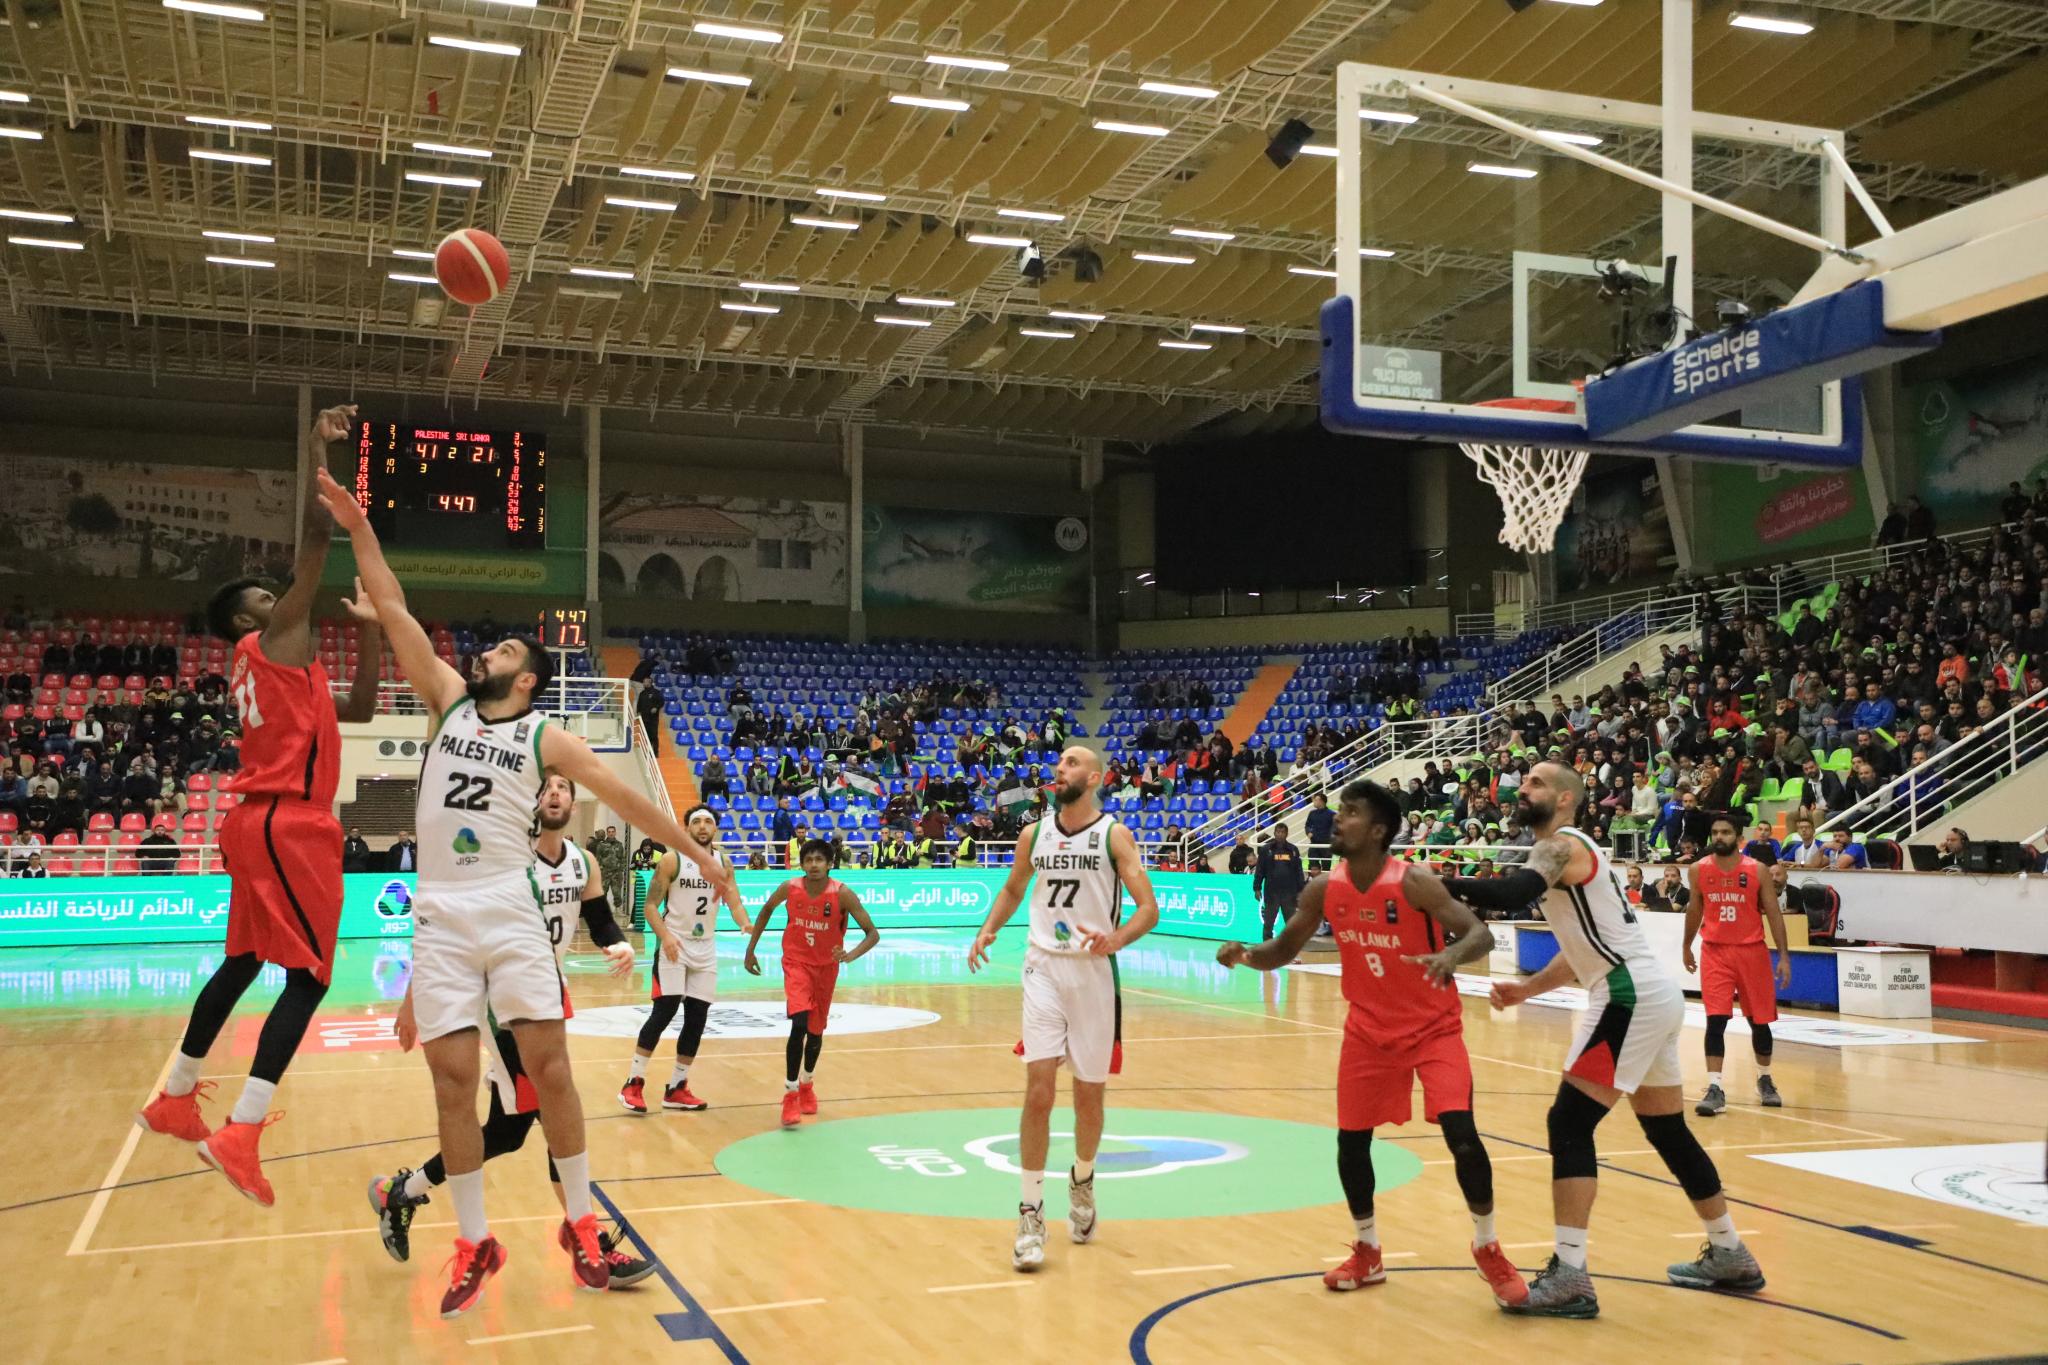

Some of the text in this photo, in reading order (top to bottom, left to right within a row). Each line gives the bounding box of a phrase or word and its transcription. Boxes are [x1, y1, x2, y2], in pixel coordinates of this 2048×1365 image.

[1673, 330, 1760, 374] Schelde
[1673, 351, 1760, 394] Sports
[363, 422, 369, 431] 0
[389, 424, 396, 433] 3
[415, 430, 490, 442] PALESTINE SRI LANKA
[360, 440, 369, 448] 10
[389, 441, 396, 450] 2
[416, 444, 437, 459] 41
[448, 447, 457, 459] 2
[472, 446, 494, 462] 21
[420, 463, 427, 473] 3
[496, 468, 500, 477] 1
[388, 500, 394, 508] 8
[519, 569, 542, 580] جوال
[560, 625, 580, 644] 17
[440, 734, 526, 774] PALESTINE
[444, 772, 493, 811] 22
[1034, 855, 1101, 871] PALESTINE
[541, 884, 584, 905] LESTIN
[898, 887, 942, 912] الراعي
[945, 888, 980, 907] جوال
[1047, 879, 1080, 908] 77
[1707, 892, 1746, 903] SRI LANKA
[64, 898, 135, 921] للرياضة
[139, 897, 194, 921] الدائم
[695, 896, 708, 915] 2
[1210, 895, 1230, 917] جوال
[1719, 905, 1736, 922] 28
[380, 921, 410, 934] جوال
[805, 919, 830, 931] LANKA
[804, 932, 815, 947] 5
[1358, 931, 1402, 949] LANKA
[1364, 952, 1385, 978] 8
[1861, 973, 1872, 982] CUP
[1893, 974, 1920, 983] ASIA CUP
[1900, 983, 1926, 991] QUALIFIERS
